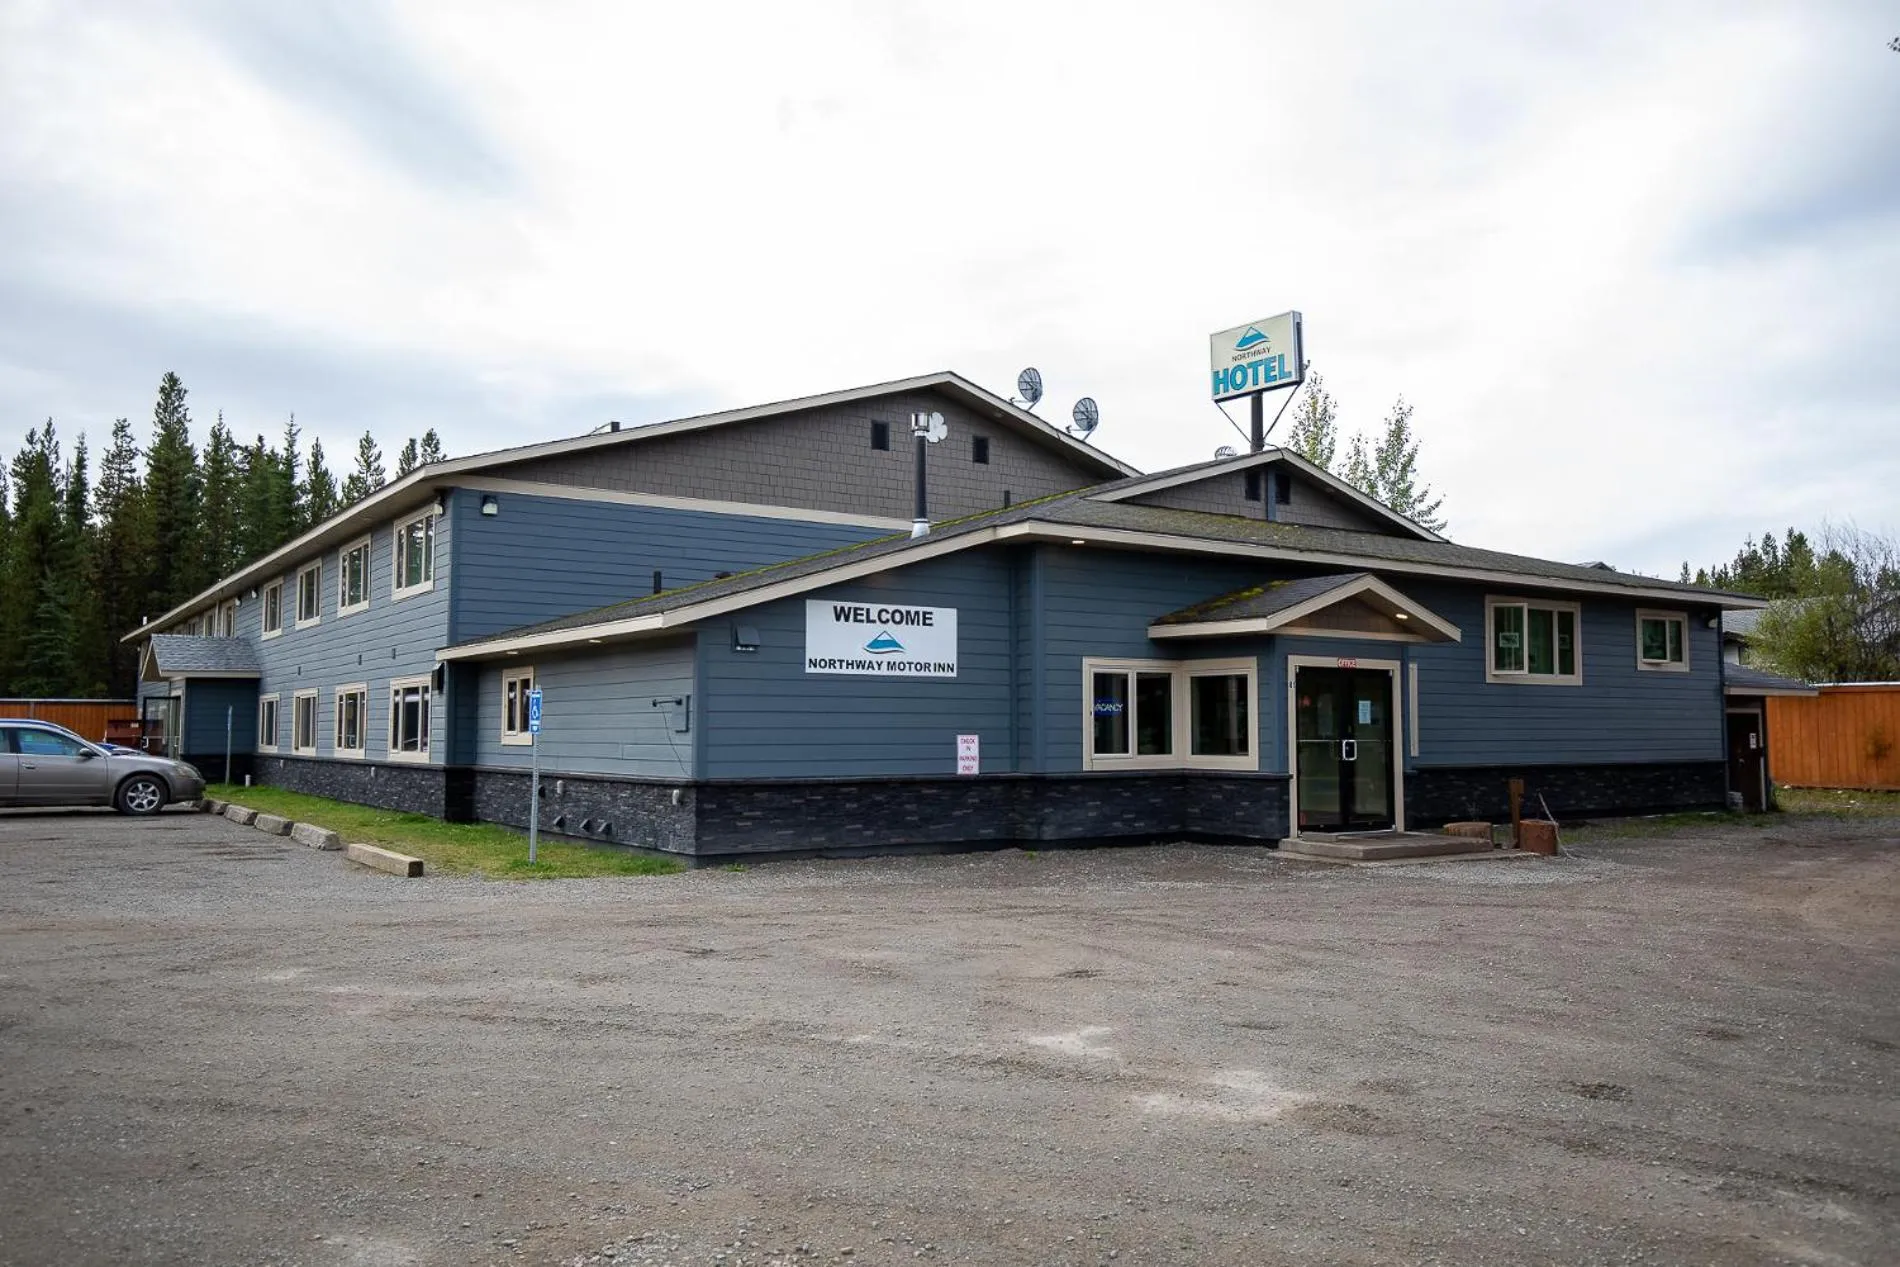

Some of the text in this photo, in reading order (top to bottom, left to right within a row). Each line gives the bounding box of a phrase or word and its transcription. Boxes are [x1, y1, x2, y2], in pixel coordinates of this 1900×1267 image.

[1232, 346, 1271, 362] NORTHWAY
[1213, 353, 1293, 396] HOTEL
[833, 605, 934, 627] WELCOME
[808, 658, 955, 673] NORTHWAY MOTOR INN
[1338, 658, 1356, 668] OFFICE
